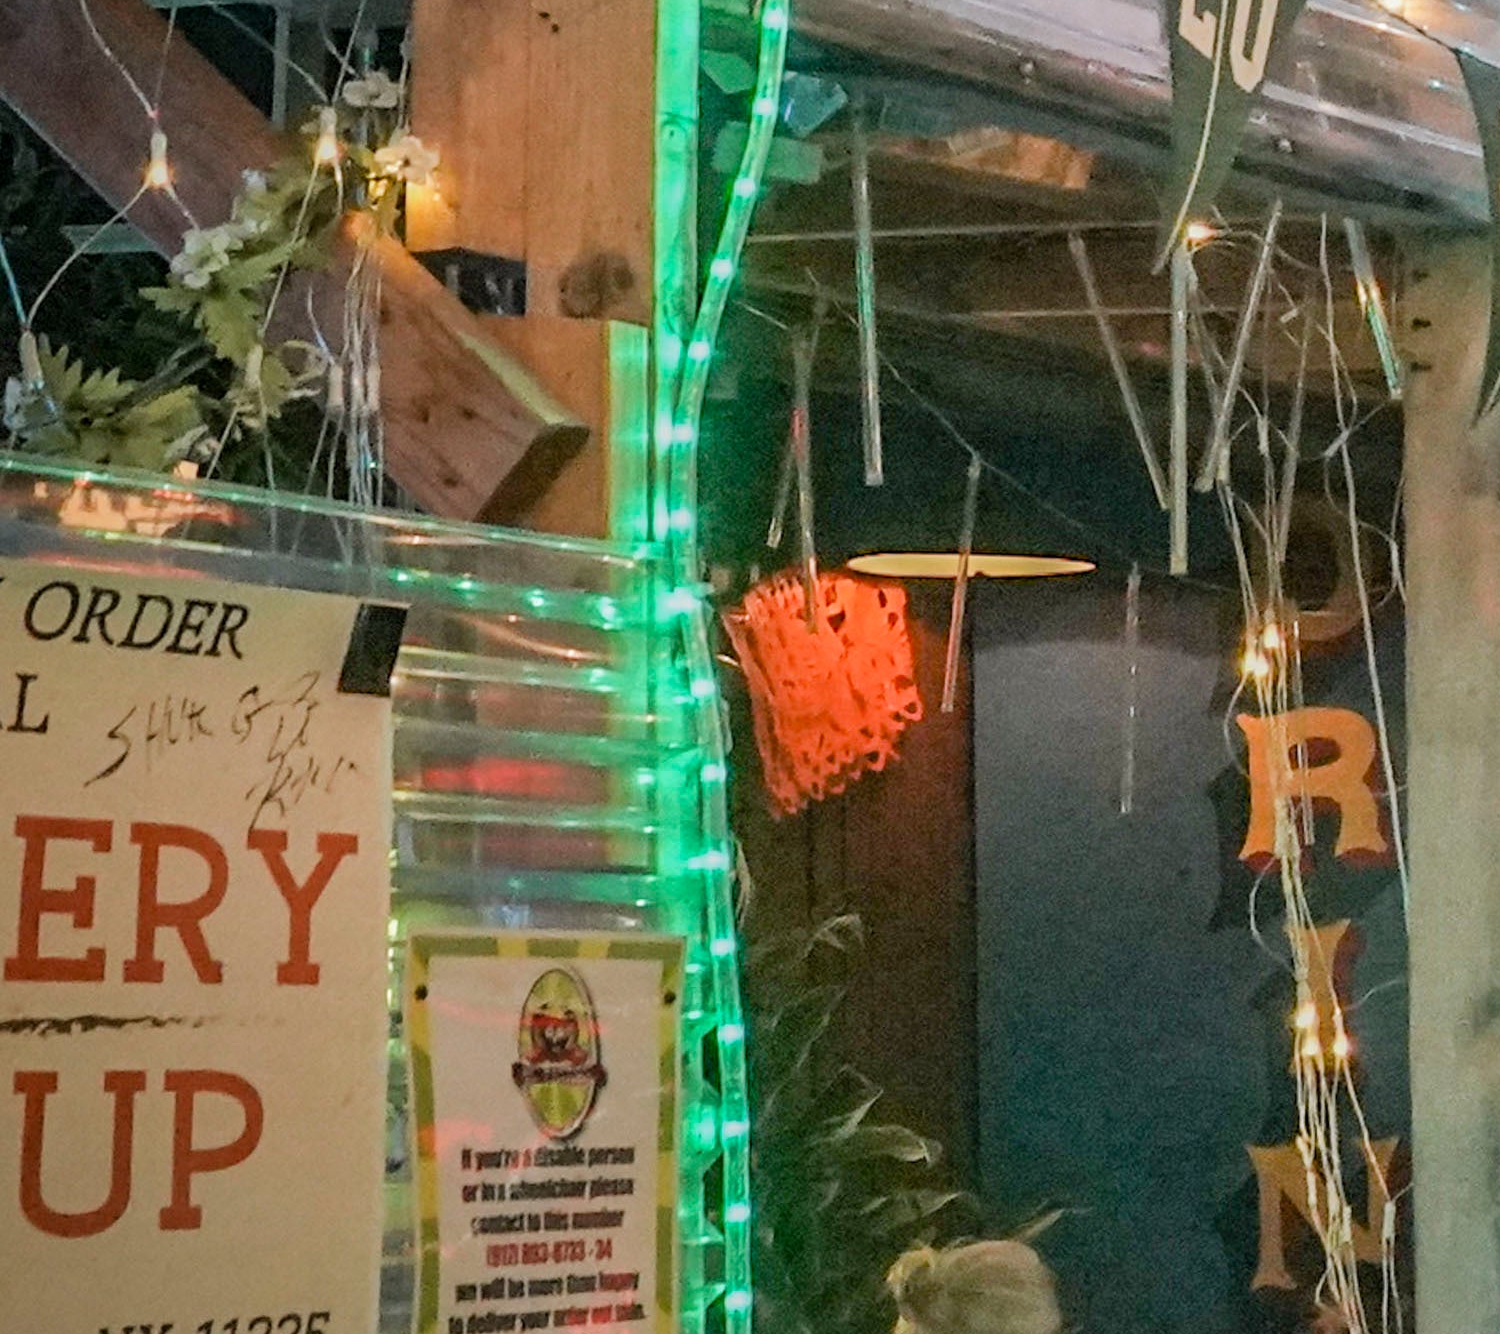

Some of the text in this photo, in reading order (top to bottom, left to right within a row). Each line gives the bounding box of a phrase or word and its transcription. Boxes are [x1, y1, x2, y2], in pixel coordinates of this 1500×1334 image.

[24, 581, 249, 660] ORDER
[0, 672, 50, 734] L
[3, 814, 359, 985] ERY
[13, 1069, 264, 1238] UP
[475, 1147, 520, 1172] you're
[587, 1147, 635, 1168] person
[589, 1178, 634, 1200] please
[471, 1212, 525, 1236] contact
[571, 1210, 625, 1230] number
